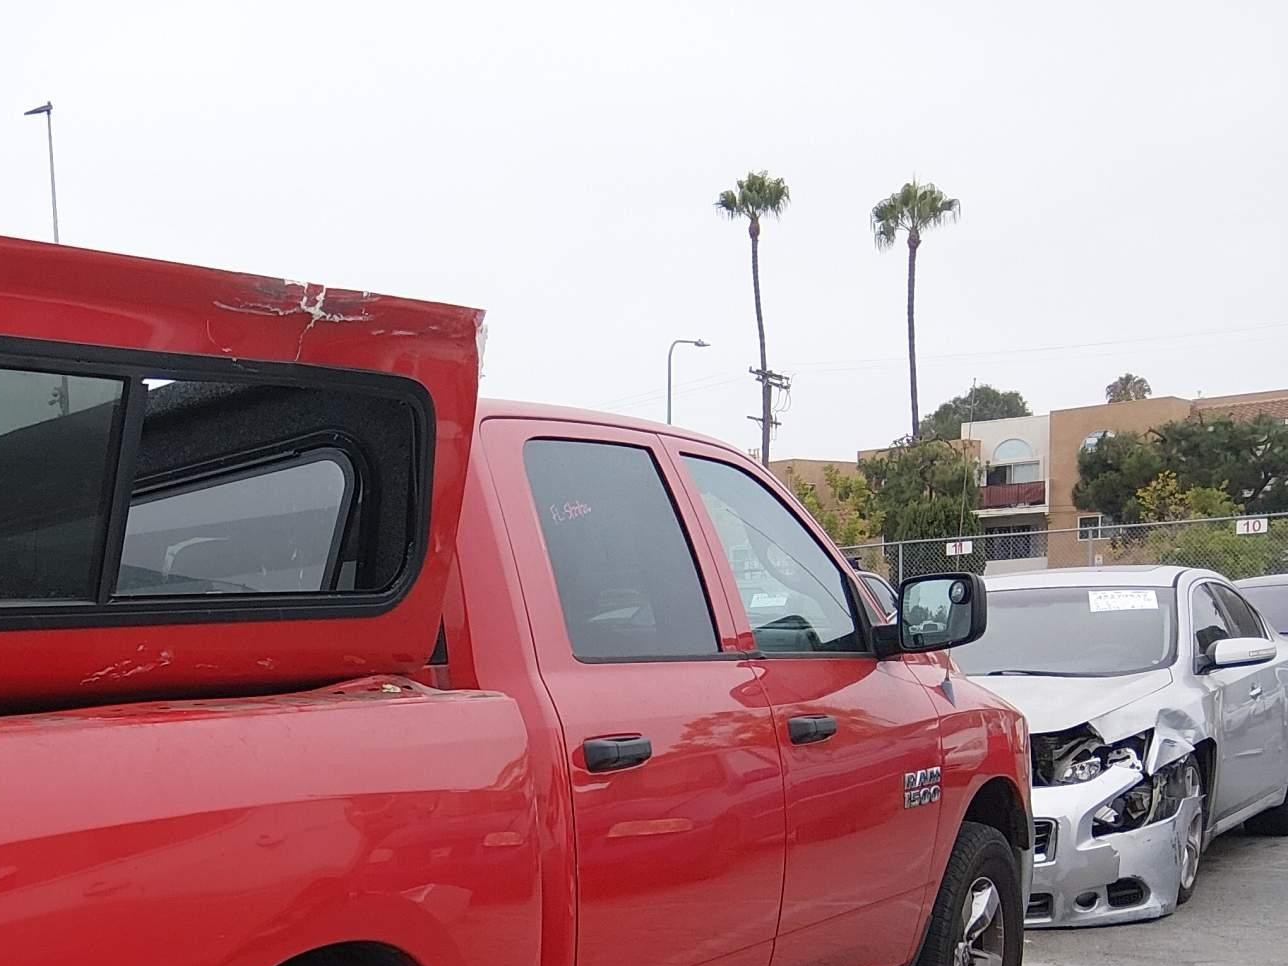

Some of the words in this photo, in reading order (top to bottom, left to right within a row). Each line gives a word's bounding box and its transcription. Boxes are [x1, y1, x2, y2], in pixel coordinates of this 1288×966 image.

[1243, 519, 1262, 533] 10
[952, 542, 963, 554] 11
[904, 766, 941, 790] RAM
[904, 785, 941, 809] 1500
